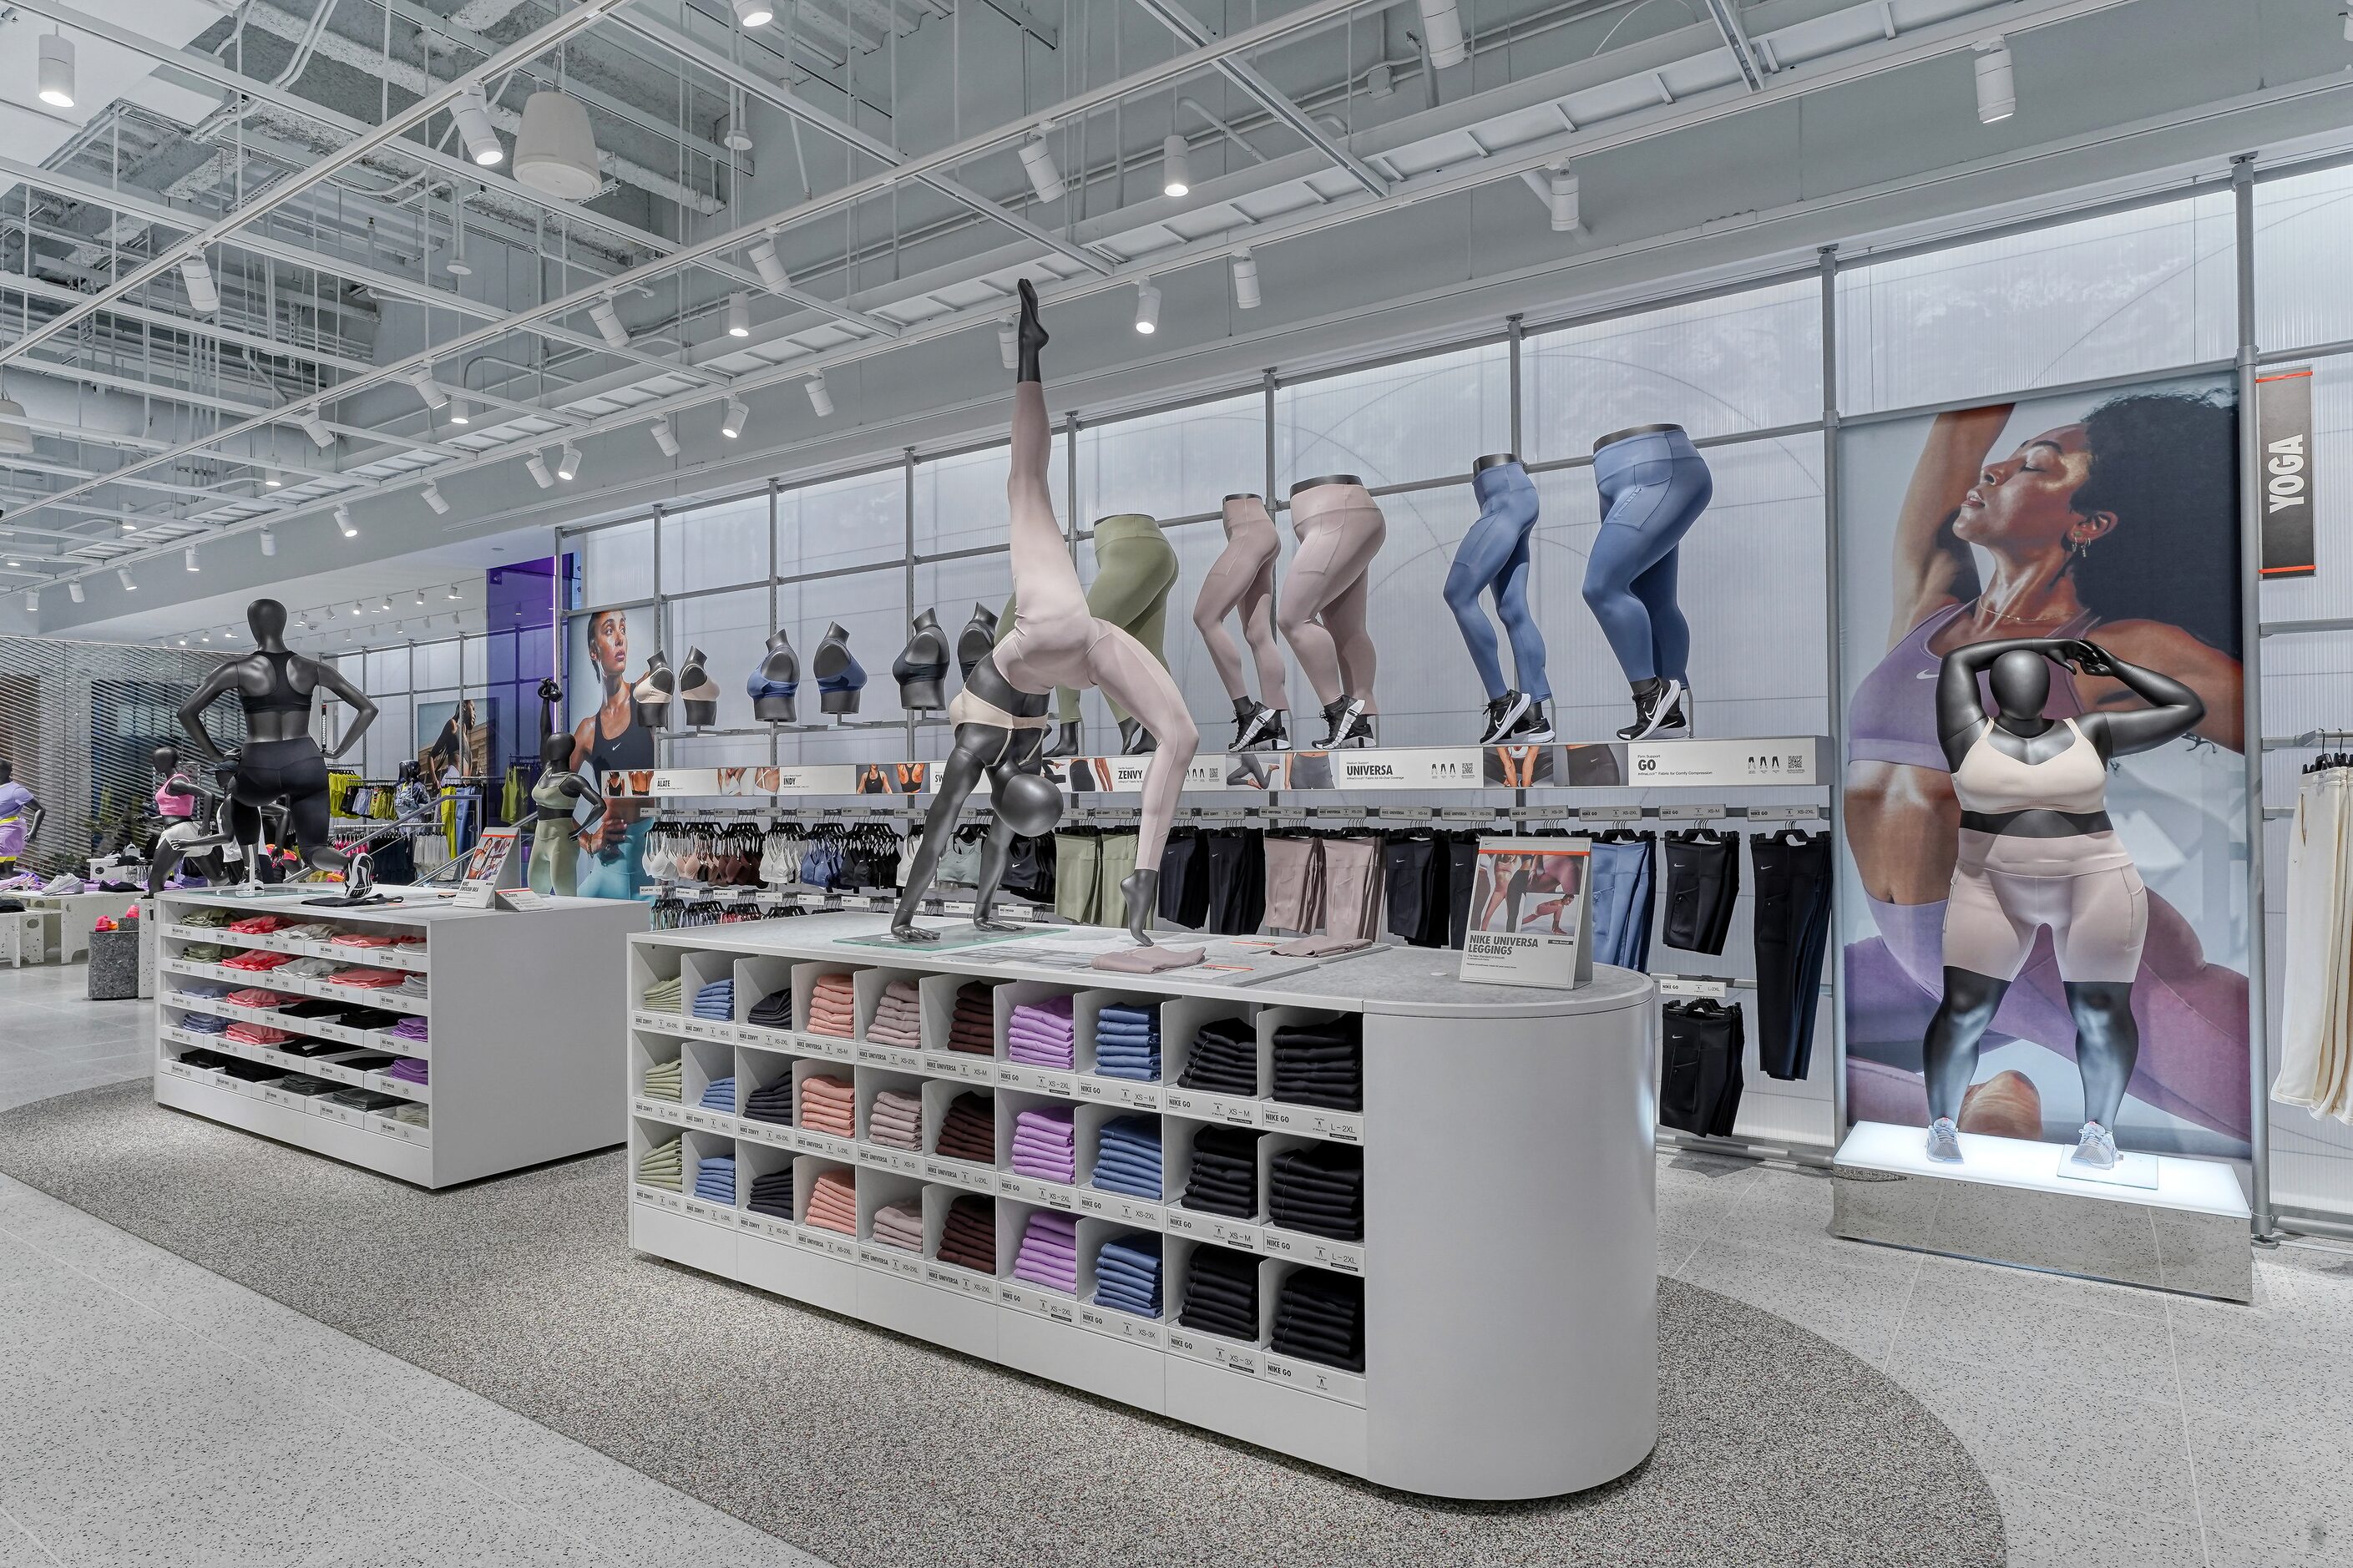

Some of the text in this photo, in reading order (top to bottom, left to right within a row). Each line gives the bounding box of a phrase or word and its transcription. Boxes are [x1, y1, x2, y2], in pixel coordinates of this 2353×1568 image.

[2268, 433, 2305, 513] YOGA
[1638, 759, 1657, 771] GO
[1119, 770, 1142, 779] ZENVY
[1347, 765, 1393, 776] UNIVERSA
[783, 777, 796, 786] INDY
[1470, 935, 1490, 944] NIKE
[1493, 936, 1538, 948] UNIVERSA
[1468, 944, 1513, 955] LEGGINGS
[805, 1042, 822, 1050] UNIVERSA
[868, 1052, 887, 1060] UNIVERSA
[937, 1062, 956, 1071] UNIVERSA
[806, 1141, 822, 1150] UNIVERSA
[860, 1151, 888, 1163] NIKE UNIVERSA
[928, 1166, 957, 1179] NIKE UNIVERSA
[1082, 1199, 1093, 1207] NIKE
[1136, 1211, 1156, 1220] XS-2XL
[1171, 1218, 1182, 1227] NIKE
[798, 1235, 823, 1247] NIKE UNIVERSA
[1267, 1239, 1279, 1247] NIKE
[837, 1246, 852, 1255] XS-2XL
[861, 1252, 888, 1265] NIKE UNIVERSA
[1343, 1256, 1356, 1264] 2XL
[903, 1264, 918, 1273] XS-2XL
[929, 1271, 959, 1286] NIKE UNIVERSA
[974, 1283, 991, 1293] XS-2XL
[1003, 1292, 1013, 1300] NIKE
[1062, 1308, 1072, 1316] 2XL
[1083, 1313, 1094, 1323] NIKE
[1138, 1329, 1156, 1338] XS-3X
[1171, 1338, 1183, 1347] NIKE
[1268, 1365, 1281, 1374] NIKE
